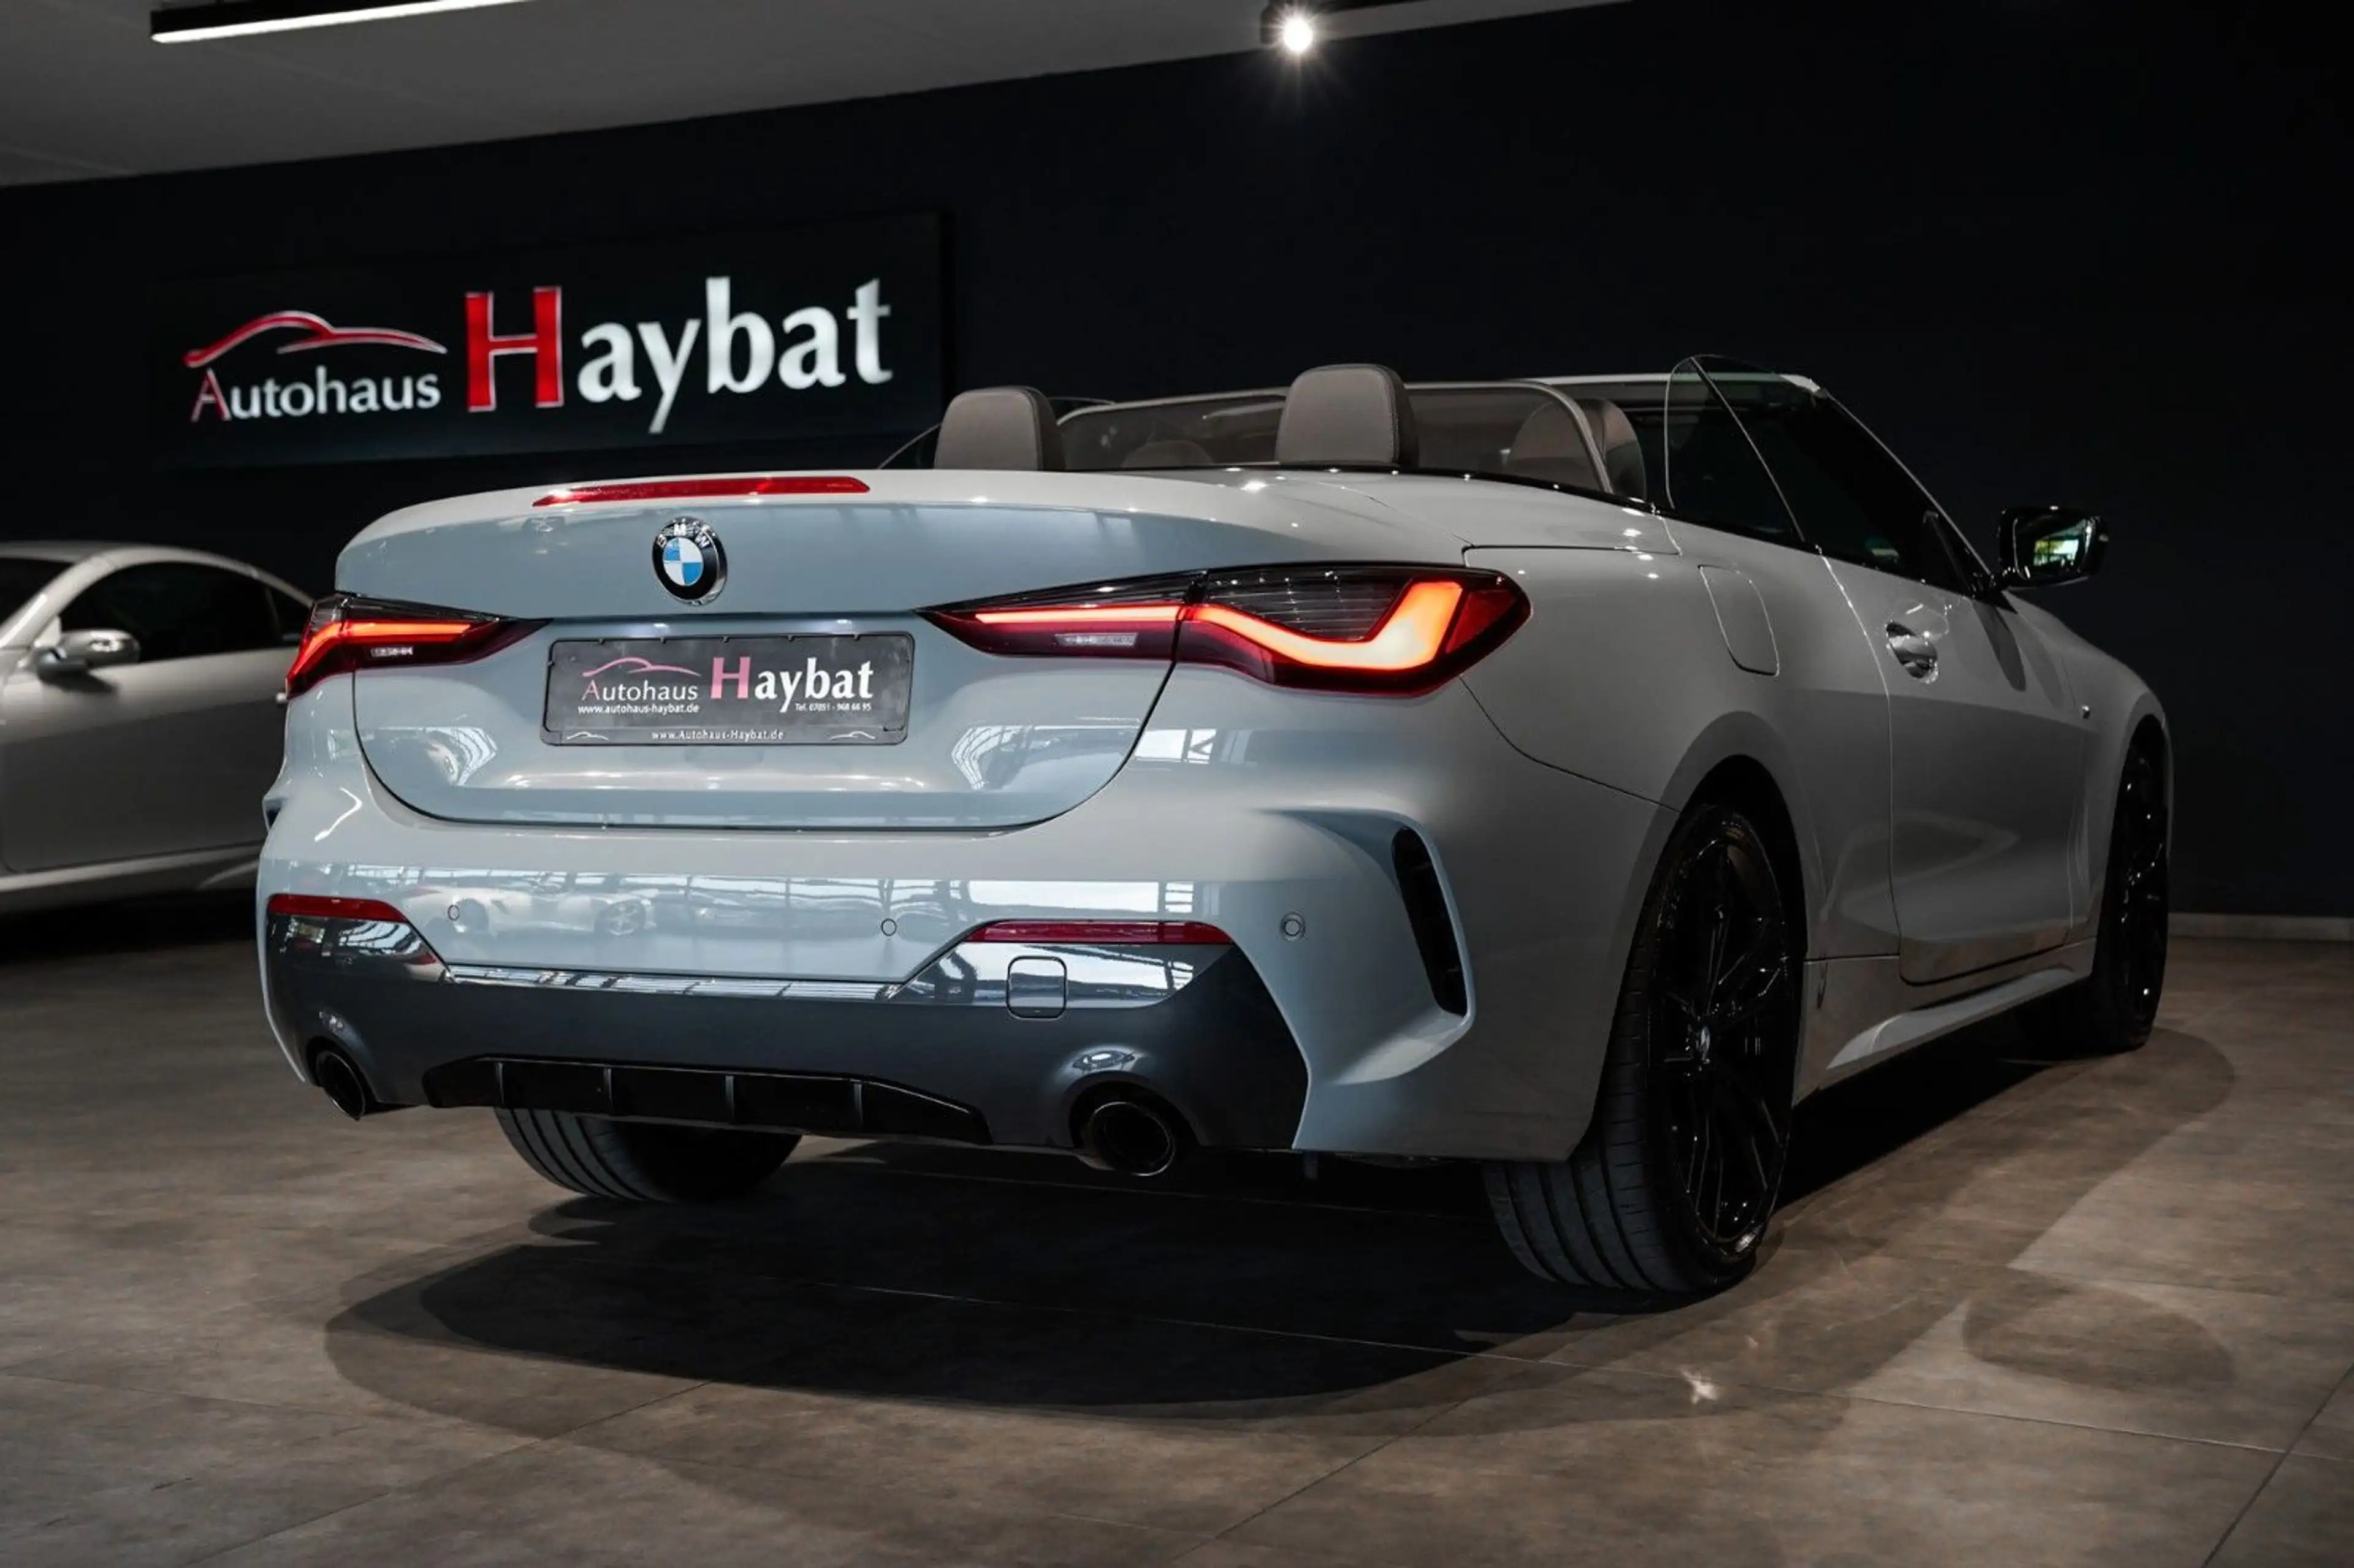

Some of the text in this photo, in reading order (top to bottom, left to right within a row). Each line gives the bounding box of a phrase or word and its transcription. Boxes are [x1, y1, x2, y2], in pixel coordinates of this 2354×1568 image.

[191, 276, 893, 433] Autohaus Haybat
[582, 656, 874, 714] Autohaus Haybat
[577, 703, 700, 716] www.autohaus-haybat.de
[651, 729, 784, 743] www.Autohaus-Haybat.de
